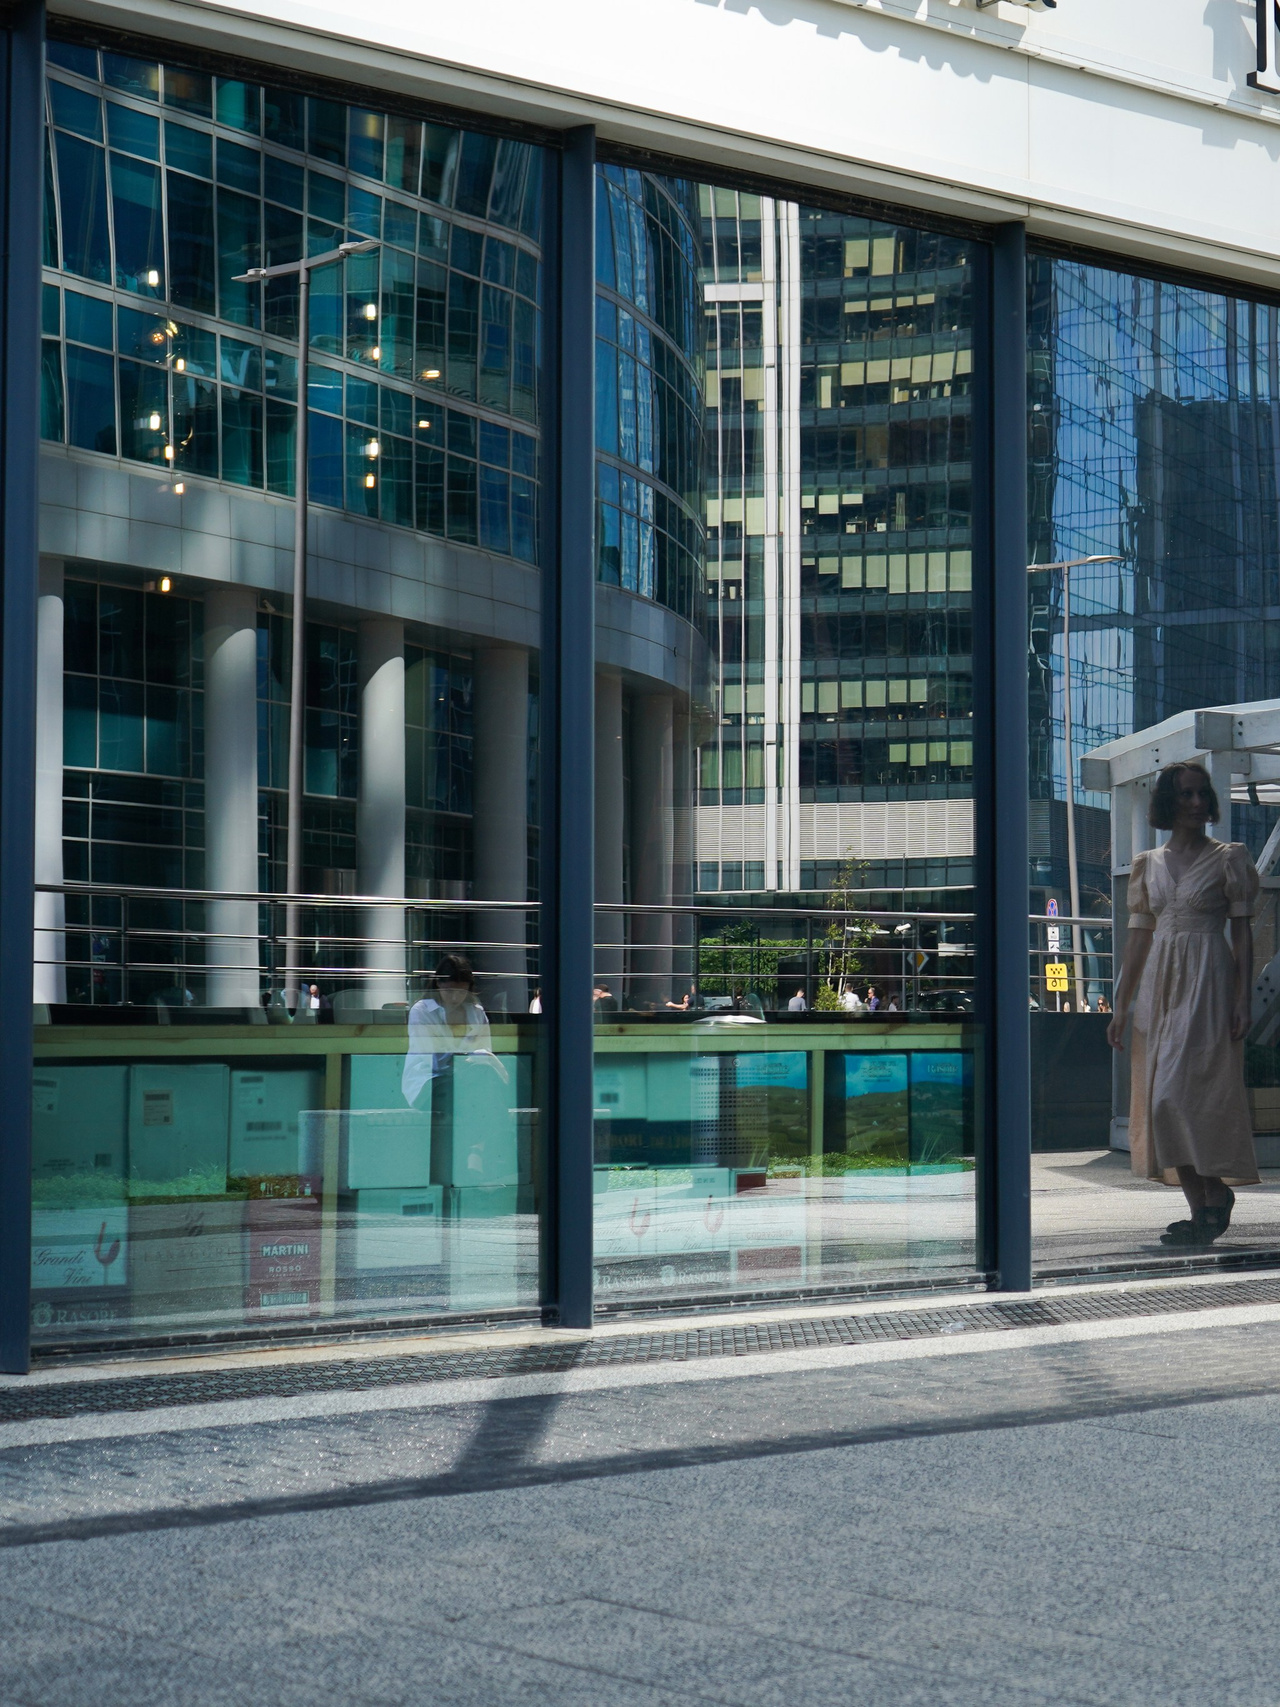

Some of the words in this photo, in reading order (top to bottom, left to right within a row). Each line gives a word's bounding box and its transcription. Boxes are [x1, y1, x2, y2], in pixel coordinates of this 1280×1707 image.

[33, 1248, 87, 1266] Grandi
[261, 1244, 310, 1257] MARTINI
[62, 1267, 96, 1286] Vini
[268, 1265, 302, 1274] ROSSO
